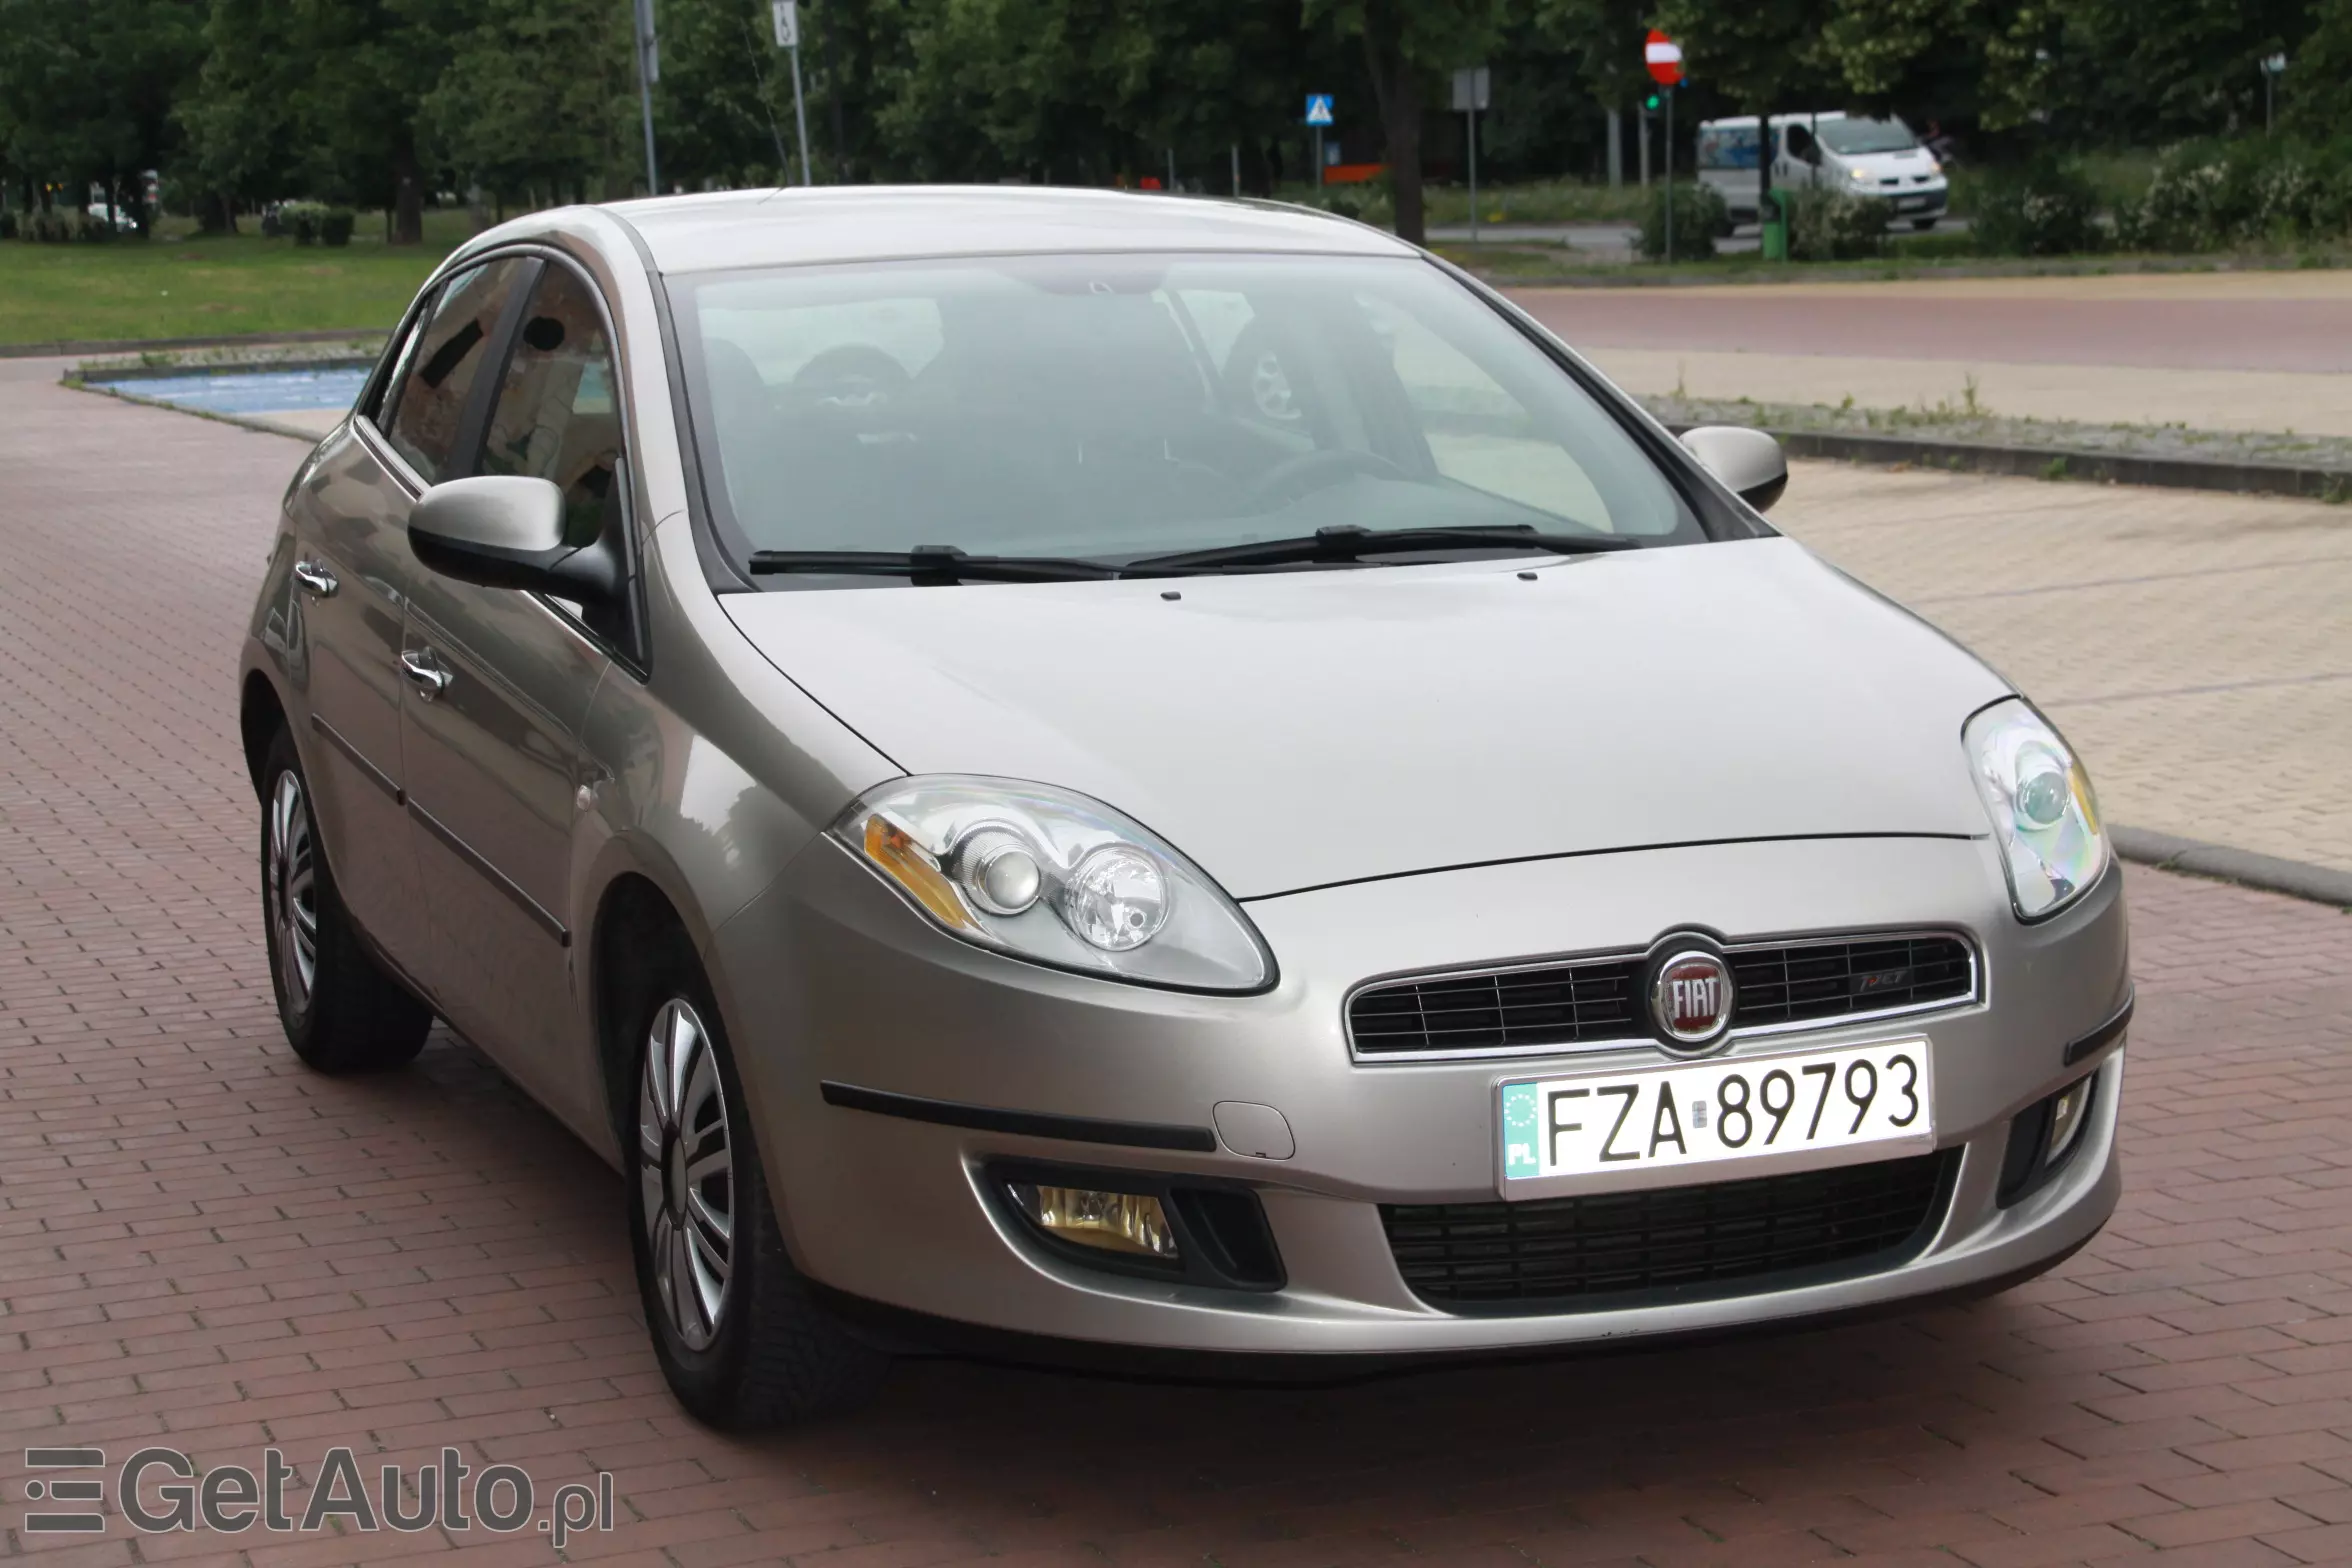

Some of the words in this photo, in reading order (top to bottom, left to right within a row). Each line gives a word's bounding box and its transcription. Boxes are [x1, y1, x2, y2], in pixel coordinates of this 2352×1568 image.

[1672, 976, 1719, 1018] FIAT
[1547, 1081, 1687, 1167] FZA
[1716, 1053, 1919, 1150] 89793
[1507, 1142, 1537, 1166] PL
